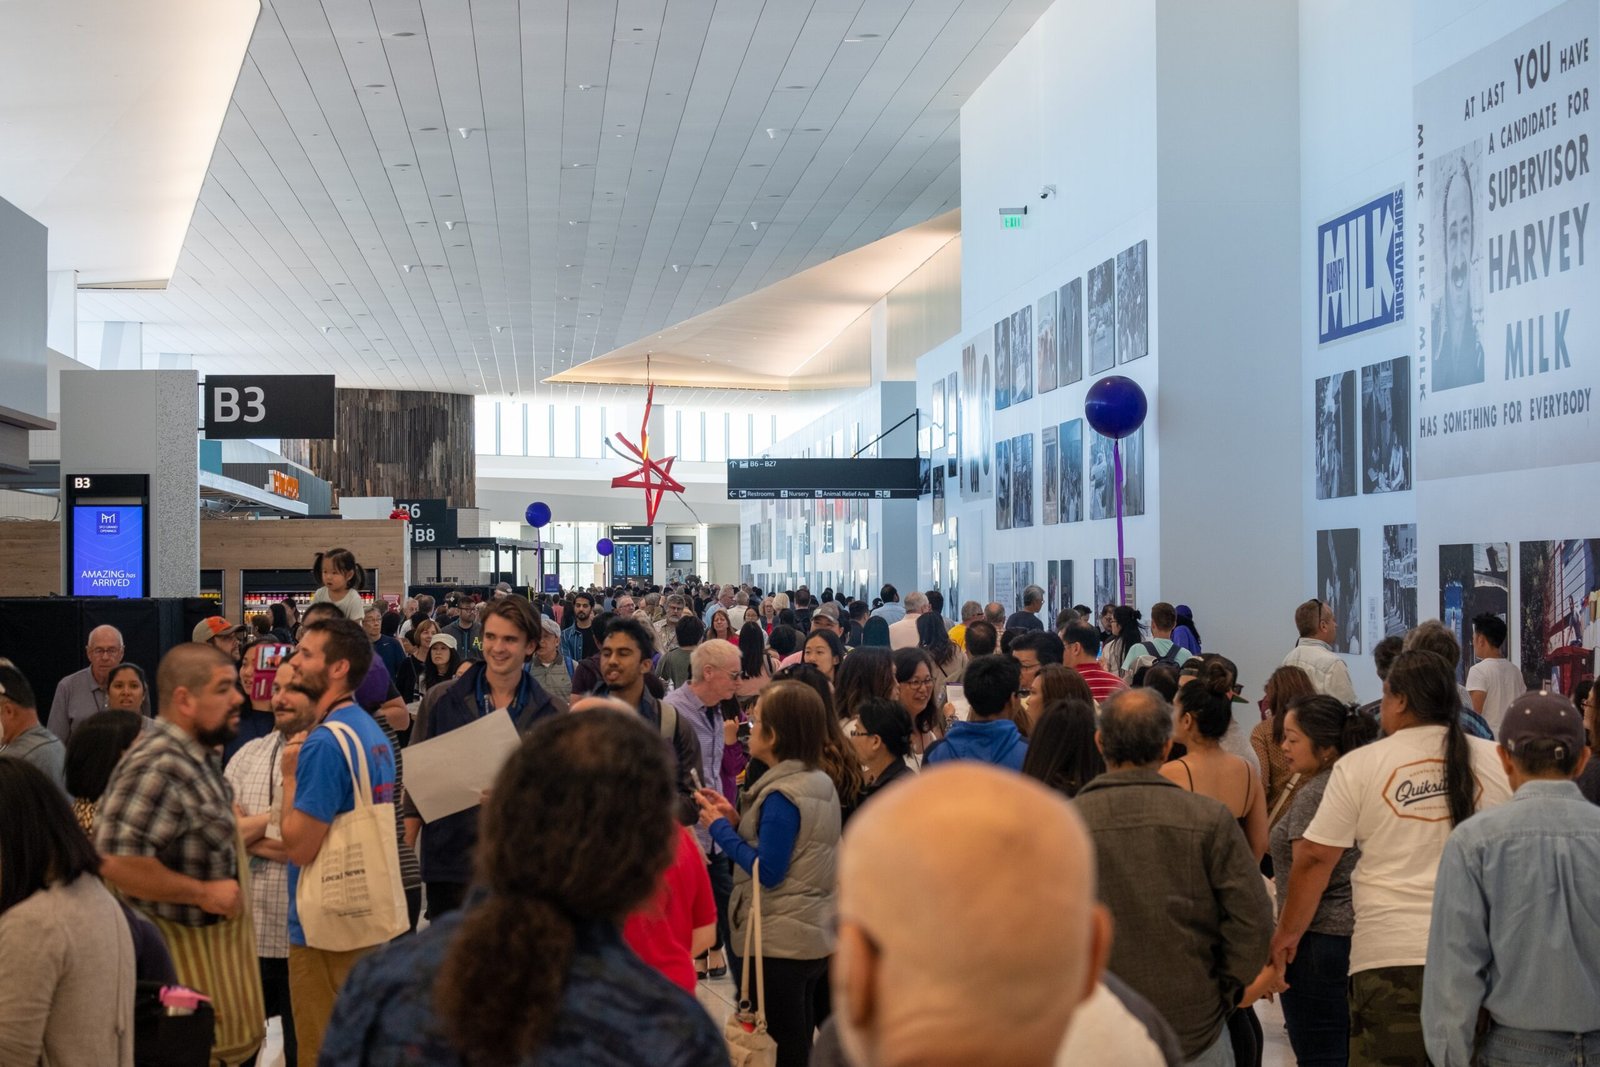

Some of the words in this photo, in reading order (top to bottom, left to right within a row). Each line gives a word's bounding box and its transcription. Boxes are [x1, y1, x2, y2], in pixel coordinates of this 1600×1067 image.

[1464, 96, 1475, 121] AT
[1481, 81, 1504, 113] LAST
[1514, 41, 1551, 94] YOU
[1560, 38, 1589, 74] HAVE
[1488, 133, 1495, 155] A
[1500, 102, 1557, 149] CANDIDATE
[1568, 88, 1589, 119] FOR
[1488, 133, 1590, 212] SUPERVISOR
[1321, 204, 1395, 335] MILK
[1394, 188, 1405, 322] SUPERVISOR
[1488, 202, 1590, 294] HARVEY
[1326, 257, 1345, 295] HARVEY
[1419, 326, 1427, 402] MILK
[1505, 308, 1571, 381] MILK
[213, 386, 266, 423] B3
[1420, 415, 1438, 438] HAS
[1443, 404, 1497, 435] SOMETHING
[1503, 400, 1522, 426] FOR
[1530, 387, 1592, 421] EVERYBODY
[74, 477, 91, 489] B3
[789, 490, 809, 498] Nursery
[415, 528, 436, 542] B8
[81, 570, 125, 579] AMAZING
[92, 578, 131, 587] ARRIVED
[321, 872, 344, 883] Local
[344, 868, 366, 878] News
